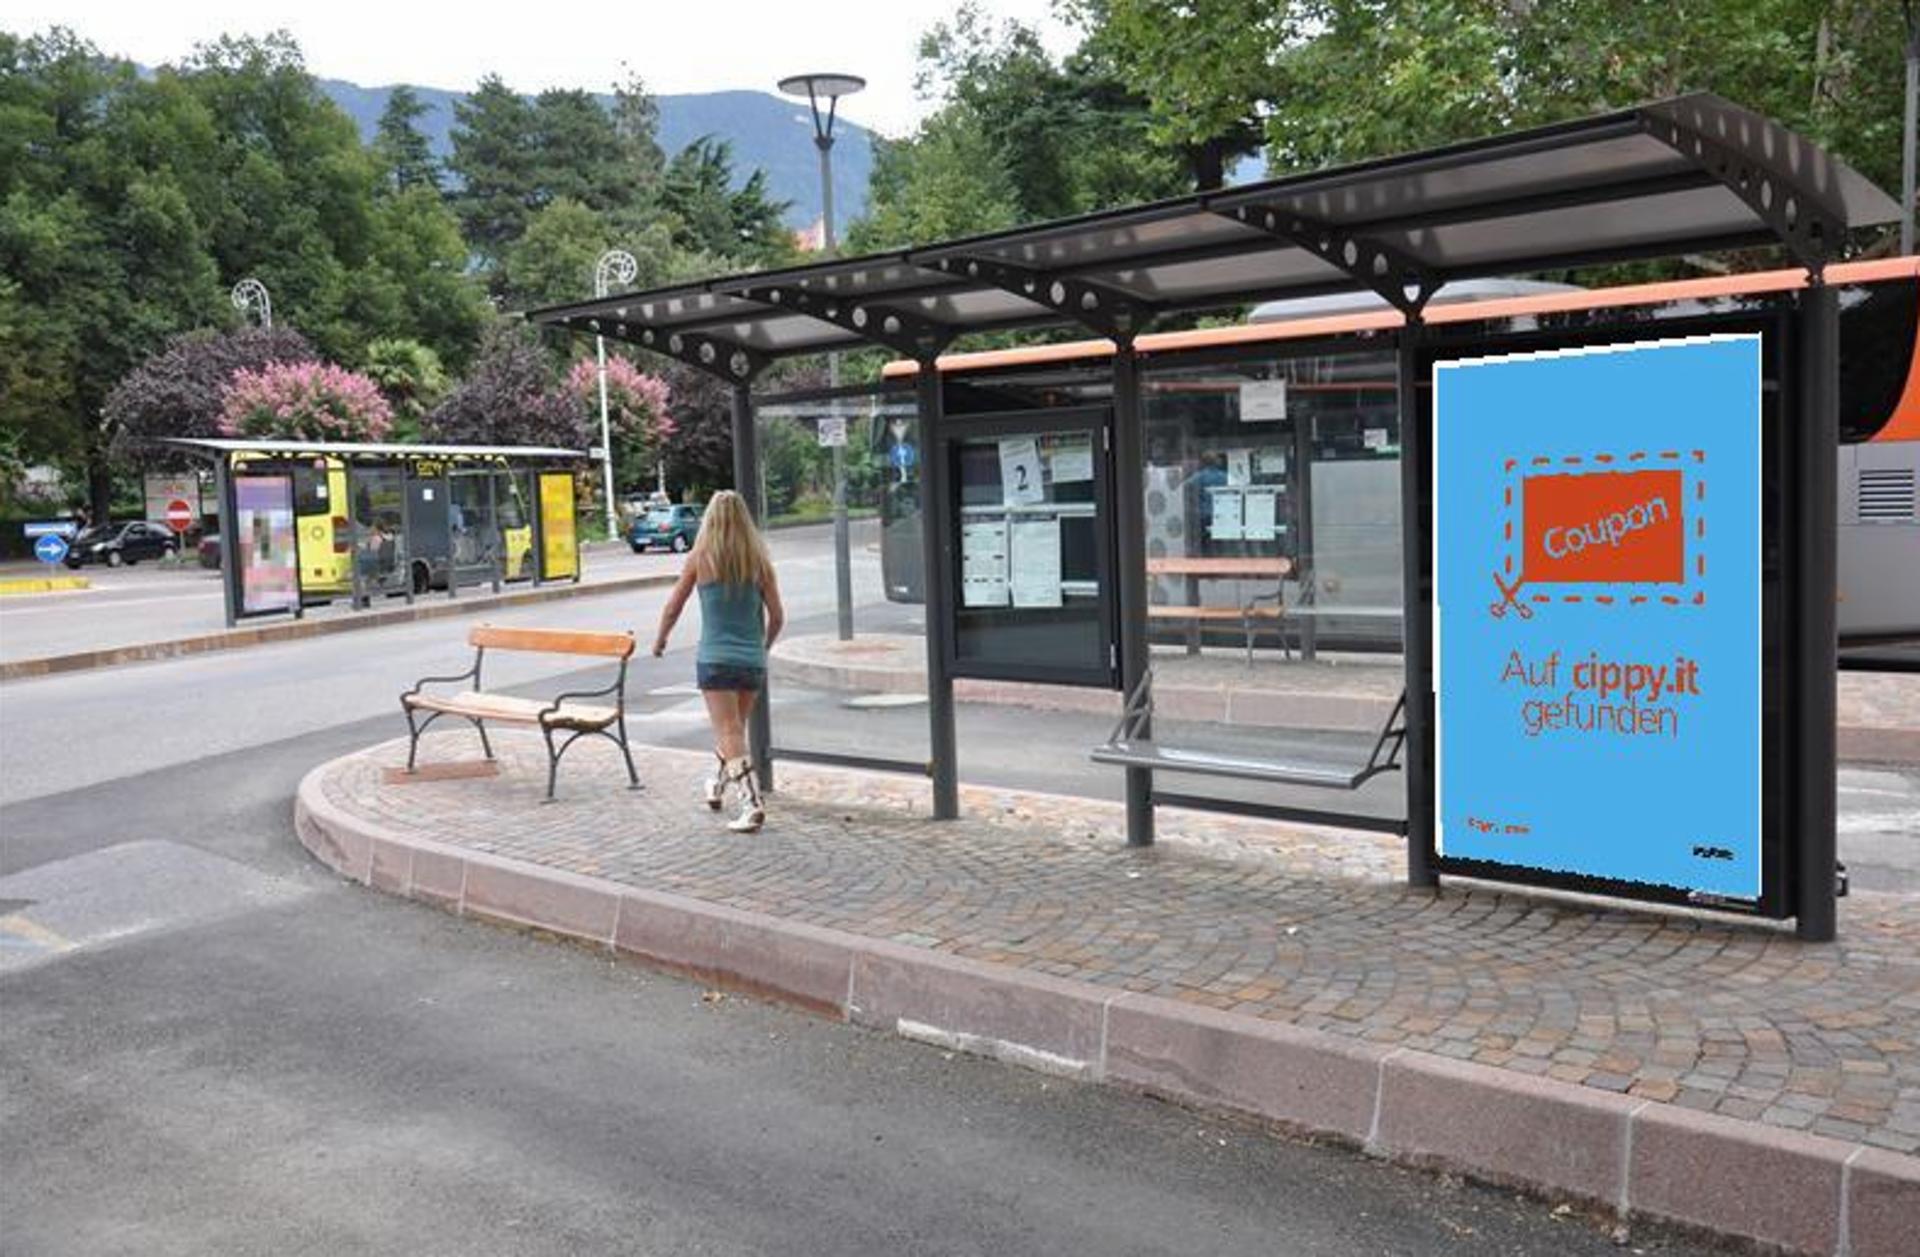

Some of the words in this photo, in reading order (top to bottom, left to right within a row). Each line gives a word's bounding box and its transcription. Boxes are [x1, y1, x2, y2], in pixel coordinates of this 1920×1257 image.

[1543, 496, 1669, 560] Coupon
[1502, 649, 1562, 688] Auf
[1572, 652, 1700, 702] cippy.it
[1521, 691, 1679, 738] gefunden
